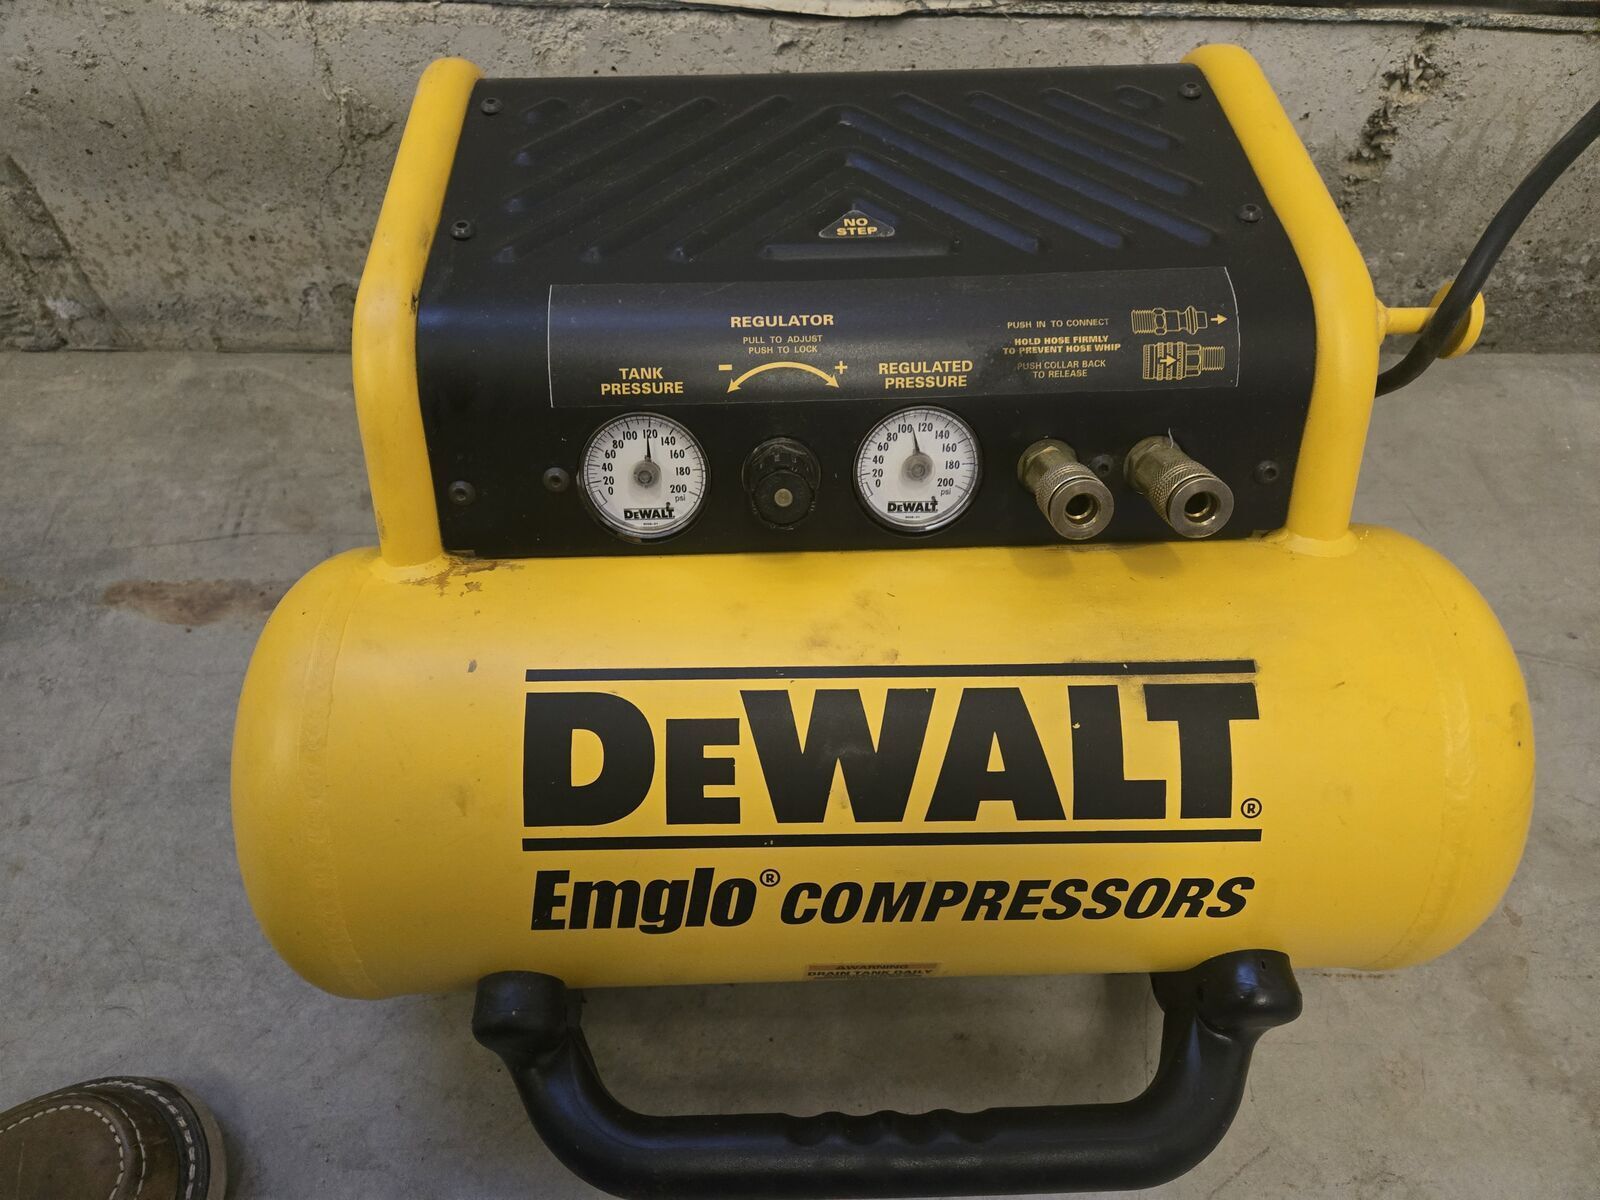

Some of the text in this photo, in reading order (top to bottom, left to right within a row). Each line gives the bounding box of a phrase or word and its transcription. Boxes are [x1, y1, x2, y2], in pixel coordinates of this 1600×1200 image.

[843, 218, 868, 226] NO
[836, 226, 878, 237] STEP
[730, 314, 834, 328] REGULATOR
[1007, 317, 1109, 329] PUSH IN TO CONNECT
[743, 334, 823, 345] PULL TO ADJUST
[1014, 335, 1109, 346] HOLD HOSE FIRMLY
[748, 345, 818, 354] PUSH TO LOCK
[1002, 343, 1121, 355] TO PREVENT HOSE WHIP
[878, 360, 973, 375] REGULATED
[1017, 359, 1106, 371] PUSH COLLAR BACK
[619, 367, 663, 380] TANK
[1033, 369, 1088, 379] TO RELEASE
[885, 375, 967, 389] PRESSURE
[601, 381, 684, 396] PRESSURE
[898, 423, 913, 434] 100
[918, 422, 933, 432] 120
[622, 430, 638, 441] 100
[643, 429, 658, 439] 120
[886, 432, 898, 442] 80
[935, 430, 950, 440] 140
[612, 440, 624, 449] 80
[661, 436, 676, 446] 140
[877, 442, 889, 452] 60
[942, 443, 957, 453] 160
[605, 450, 616, 459] 60
[670, 449, 685, 459] 160
[872, 455, 884, 465] 40
[945, 460, 960, 470] 180
[602, 463, 613, 472] 40
[675, 466, 691, 476] 180
[872, 468, 883, 478] 20
[603, 476, 614, 486] 20
[875, 479, 881, 488] 0
[937, 478, 954, 488] 200
[608, 486, 614, 496] 0
[669, 484, 687, 494] 200
[940, 488, 951, 497] psi
[674, 495, 686, 503] psi
[780, 876, 1255, 926] COMPRESSORS
